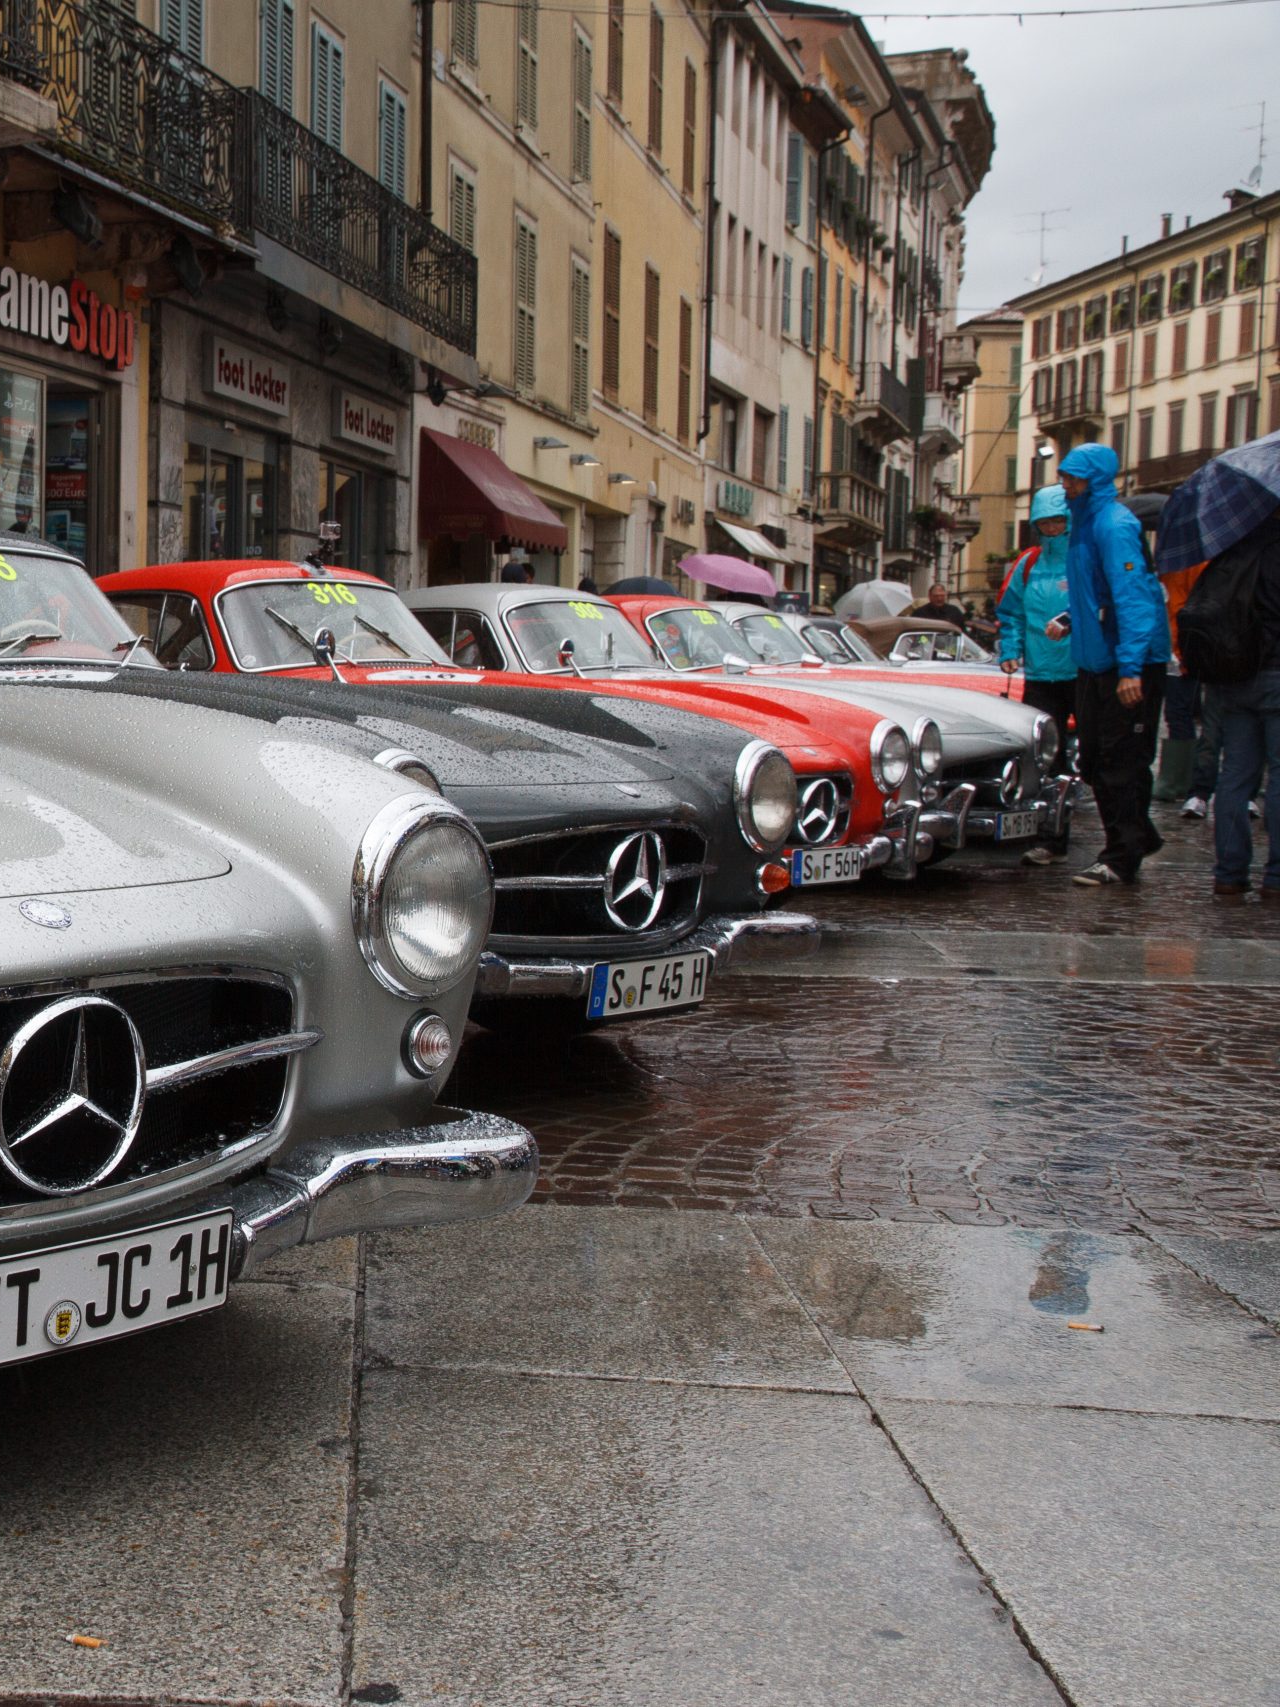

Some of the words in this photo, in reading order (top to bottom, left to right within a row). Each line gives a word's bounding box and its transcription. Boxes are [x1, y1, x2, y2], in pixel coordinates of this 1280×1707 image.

[219, 348, 245, 391] Foot
[249, 360, 287, 405] Locker
[344, 400, 365, 435] Foot
[367, 407, 395, 446] Locker
[307, 582, 358, 606] 316
[803, 854, 813, 880] S
[823, 853, 832, 879] F
[609, 968, 625, 1009] S
[639, 965, 656, 1005] F
[85, 1244, 152, 1328] JC
[166, 1223, 229, 1309] 1H
